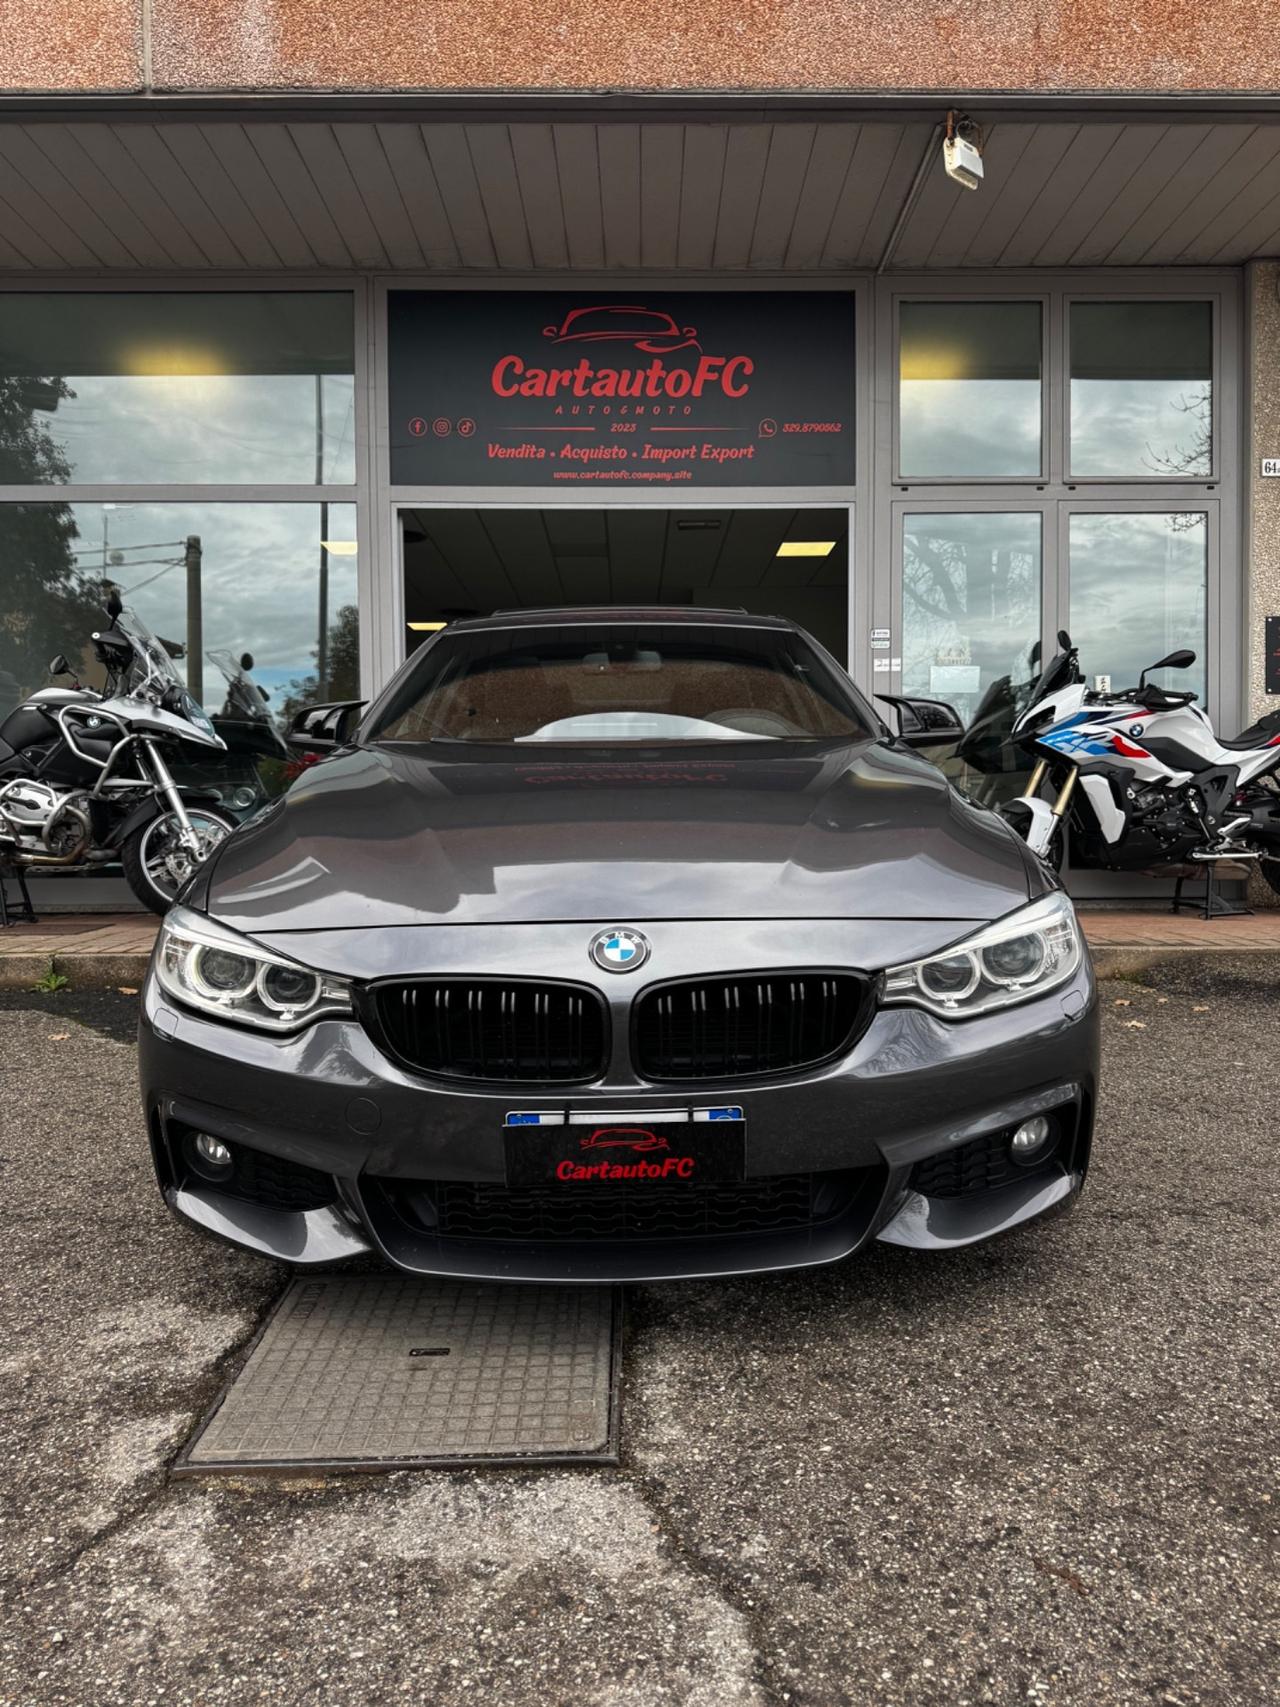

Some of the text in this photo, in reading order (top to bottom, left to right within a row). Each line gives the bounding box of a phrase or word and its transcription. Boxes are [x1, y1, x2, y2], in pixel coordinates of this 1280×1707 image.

[491, 354, 754, 398] CartautoFC
[487, 443, 754, 464] Vendita Acquisto Import Export
[553, 470, 692, 482] www.cartautofc.company.site
[556, 1157, 695, 1181] CartautoFC
